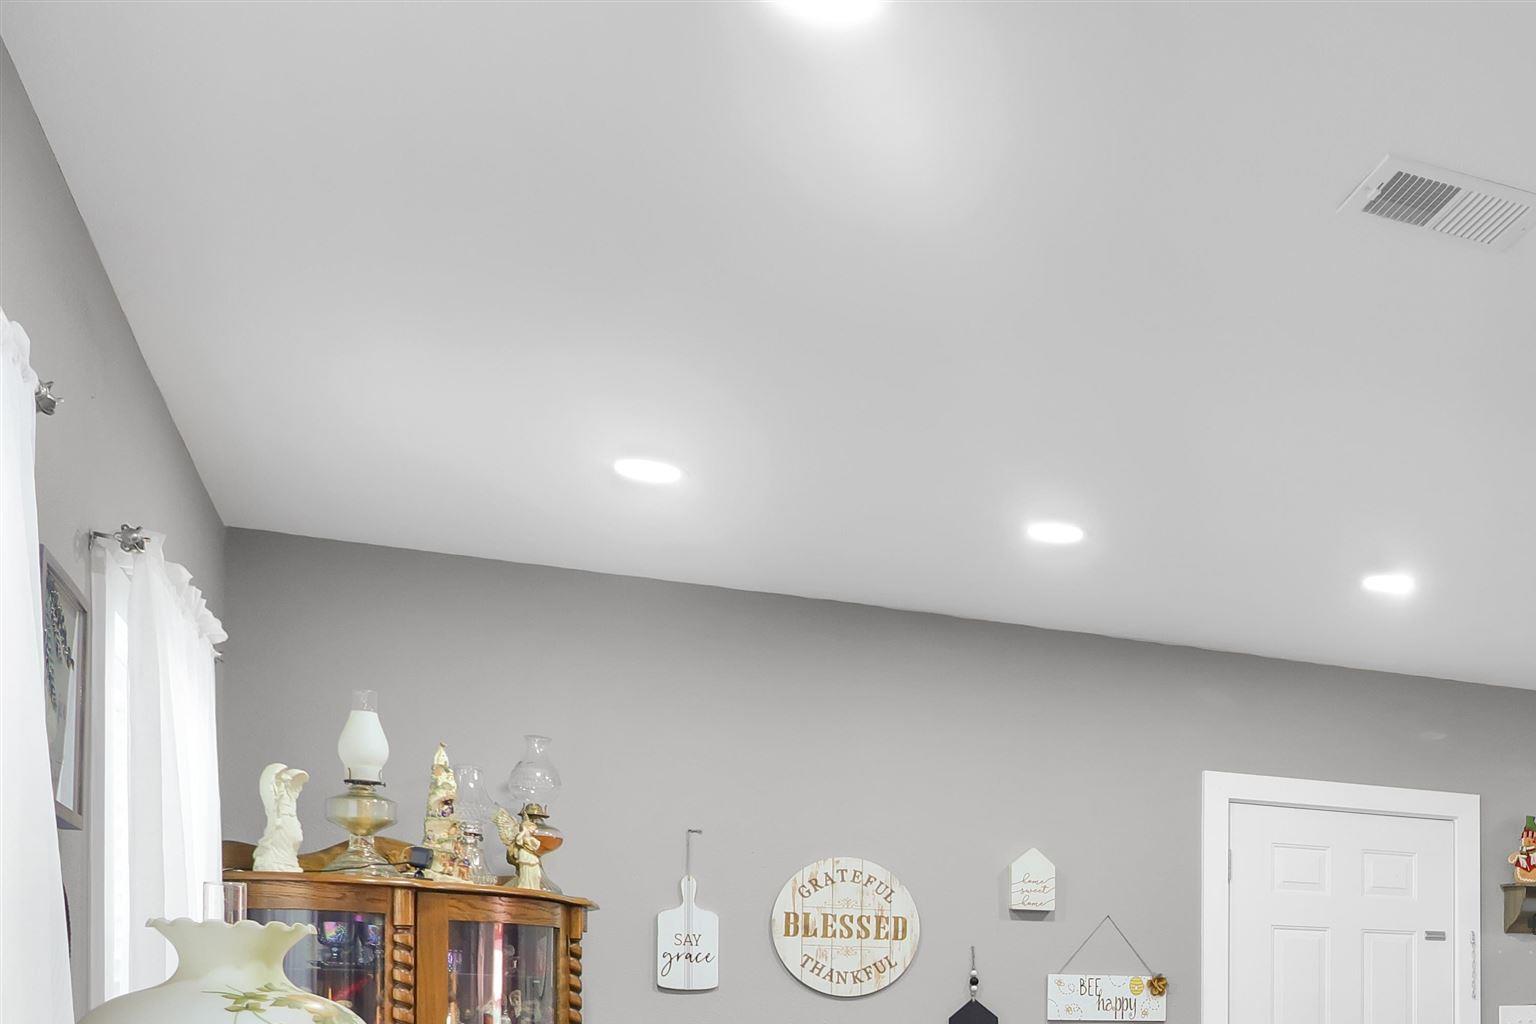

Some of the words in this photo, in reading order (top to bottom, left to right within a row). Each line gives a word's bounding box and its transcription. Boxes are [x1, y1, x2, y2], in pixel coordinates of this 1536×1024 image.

[798, 868, 896, 904] GRATEFUL
[674, 933, 702, 946] SAY
[783, 911, 908, 941] BLESSED
[661, 951, 715, 977] grace
[800, 954, 898, 984] THANKFUL
[1079, 977, 1101, 996] BEE
[1097, 989, 1137, 1019] happy
